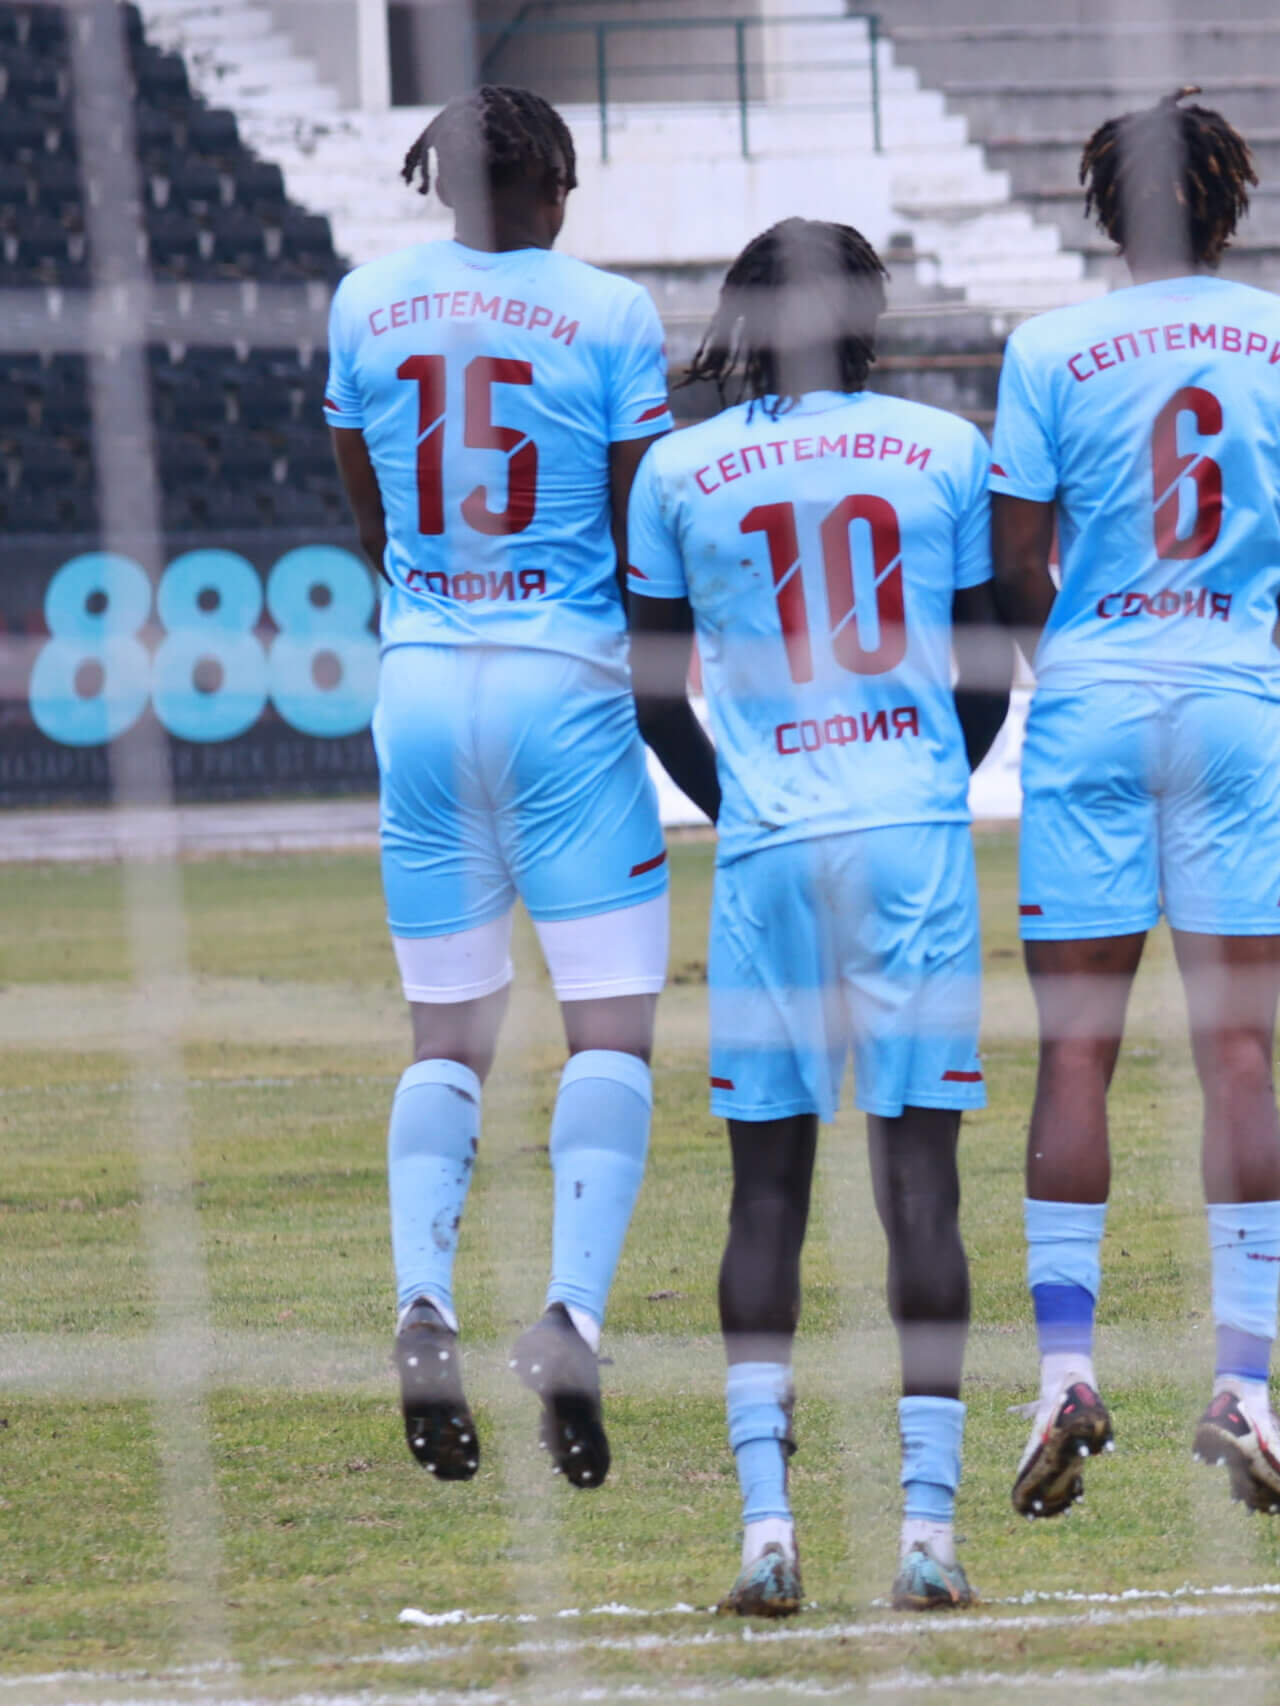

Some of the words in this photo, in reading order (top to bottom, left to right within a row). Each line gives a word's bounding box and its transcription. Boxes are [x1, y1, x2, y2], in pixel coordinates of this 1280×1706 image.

[369, 291, 580, 346] СЕПТЕМВРИ
[397, 355, 538, 535] 15
[694, 433, 932, 495] СЕПТЕМВРИ
[1153, 386, 1223, 561] 6
[739, 494, 907, 684] 10
[1095, 587, 1232, 622] СОФИЯ
[775, 706, 919, 755] СОФИЯ
